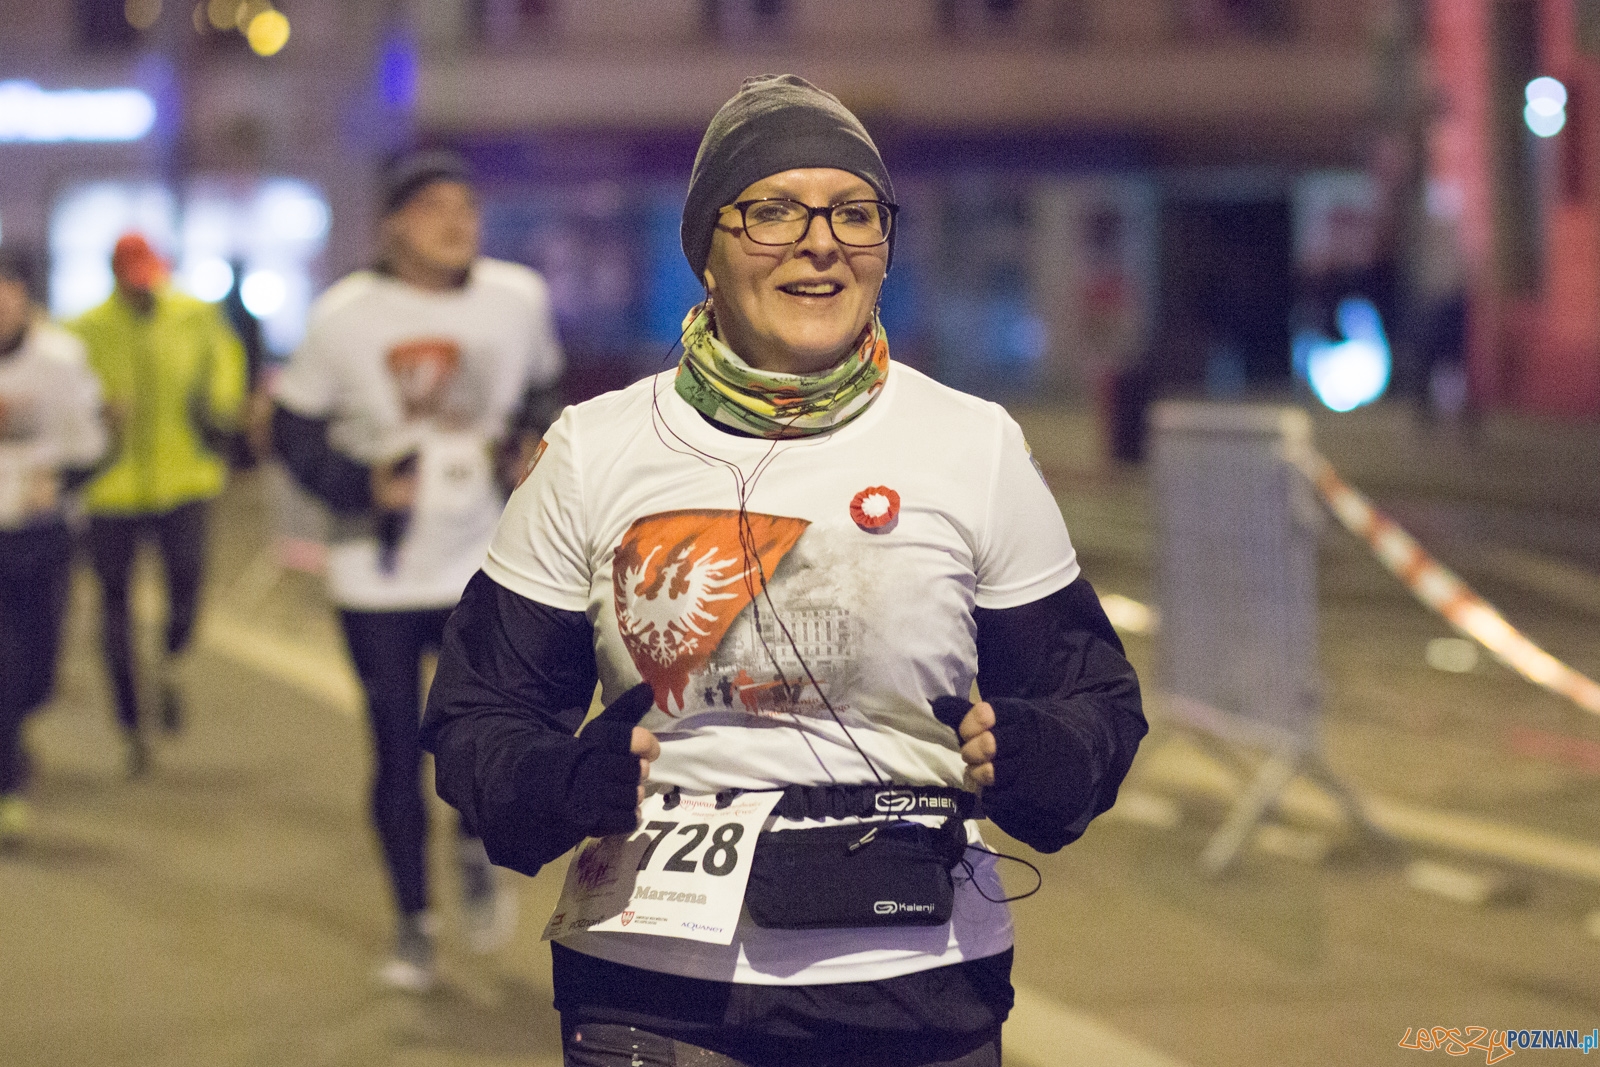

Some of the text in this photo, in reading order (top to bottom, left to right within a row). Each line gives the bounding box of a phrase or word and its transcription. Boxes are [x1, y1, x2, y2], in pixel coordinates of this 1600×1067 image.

[635, 820, 745, 877] 728
[633, 885, 707, 905] Marzena
[898, 902, 935, 914] Kalenji
[681, 921, 724, 933] AQUANET
